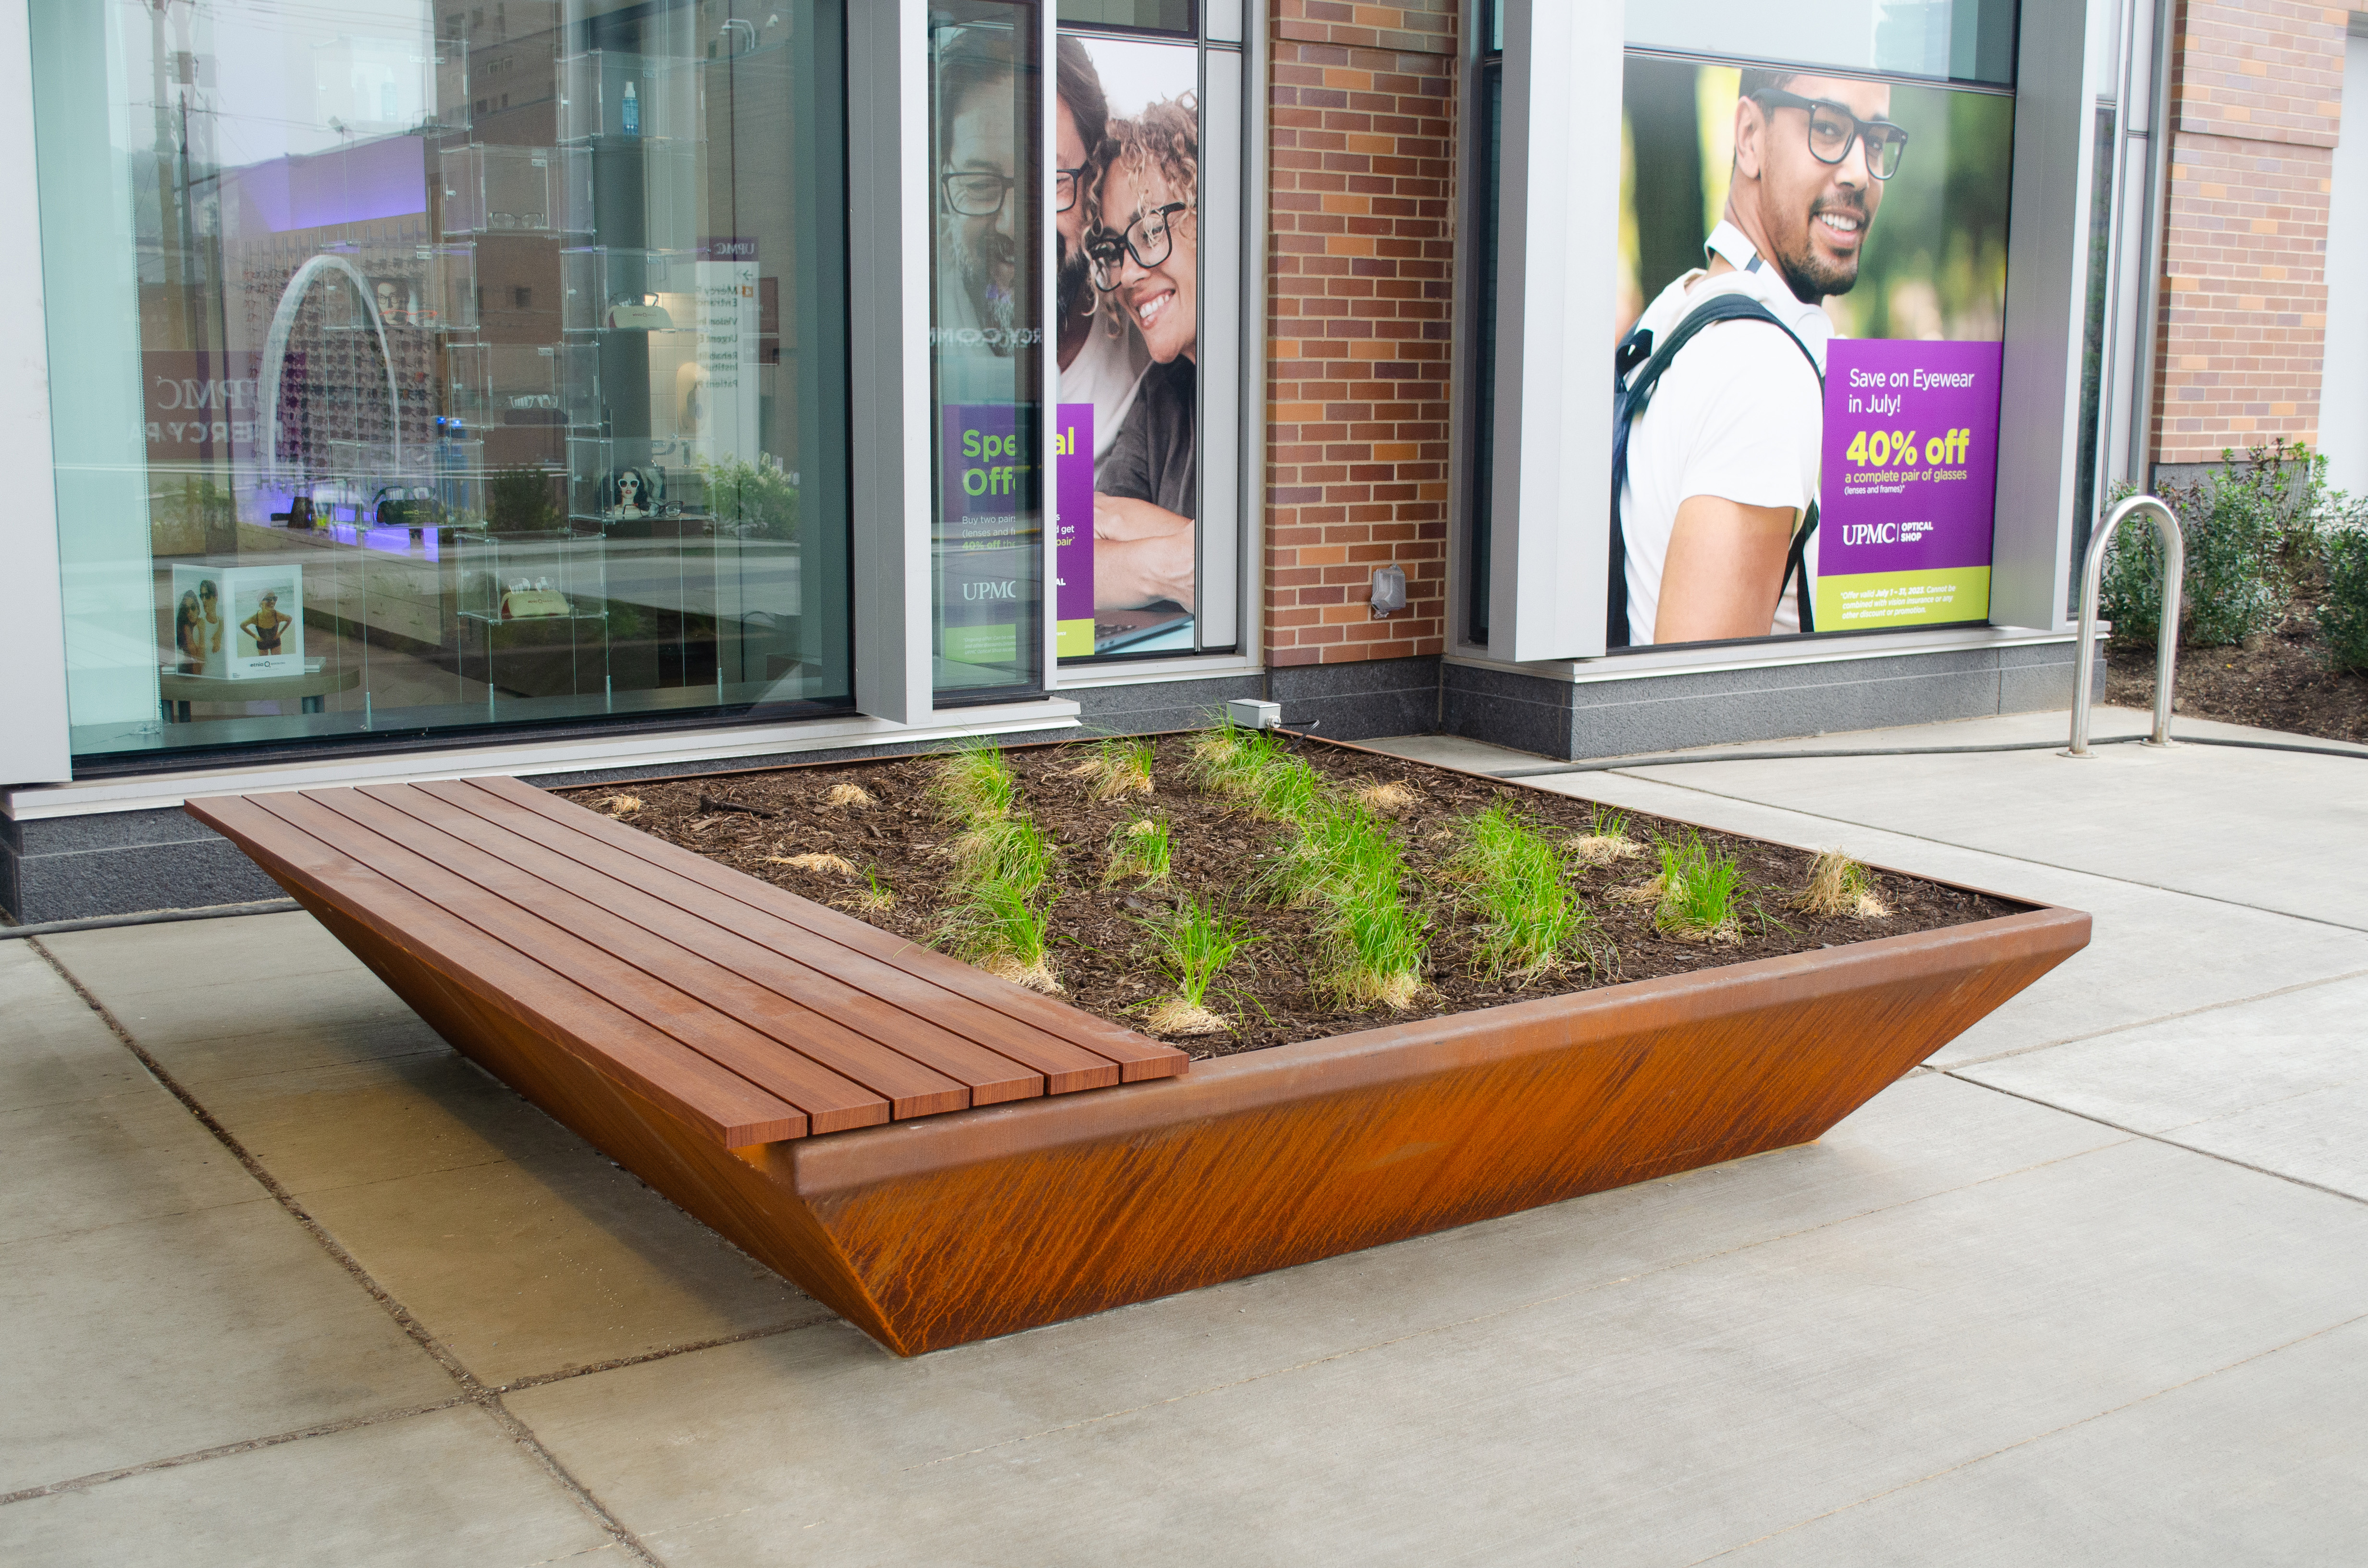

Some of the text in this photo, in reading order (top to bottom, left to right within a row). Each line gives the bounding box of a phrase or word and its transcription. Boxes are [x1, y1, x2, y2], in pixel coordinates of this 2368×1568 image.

[1850, 368, 1975, 391] Save on Eyewear
[1849, 393, 1900, 416] in July!
[962, 427, 1074, 463] Speal
[1846, 428, 1970, 466] 40% off
[962, 466, 1015, 496] Off
[1845, 468, 1967, 484] a complete pair of glasses
[1844, 486, 1866, 495] (lenses
[1867, 485, 1879, 494] and
[962, 516, 978, 525] Buy
[1901, 522, 1934, 532] OPTICAL
[962, 529, 991, 538] (lenses
[993, 528, 1008, 536] and
[1061, 525, 1074, 534] get
[1843, 523, 1896, 546] UPMC
[1900, 532, 1922, 542] SHOP
[962, 540, 984, 550] 40%
[987, 539, 1001, 549] off
[1860, 590, 1874, 598] valid
[1875, 589, 1889, 598] July
[1898, 587, 1907, 596] 31,
[1926, 585, 1947, 594] Cannot
[1842, 600, 1873, 609] combined
[1874, 599, 1887, 607] with
[1888, 598, 1905, 606] vision
[1906, 596, 1934, 604] insurance
[1842, 611, 1859, 619] other
[1860, 609, 1885, 618] discount
[1894, 607, 1926, 616] promotion.
